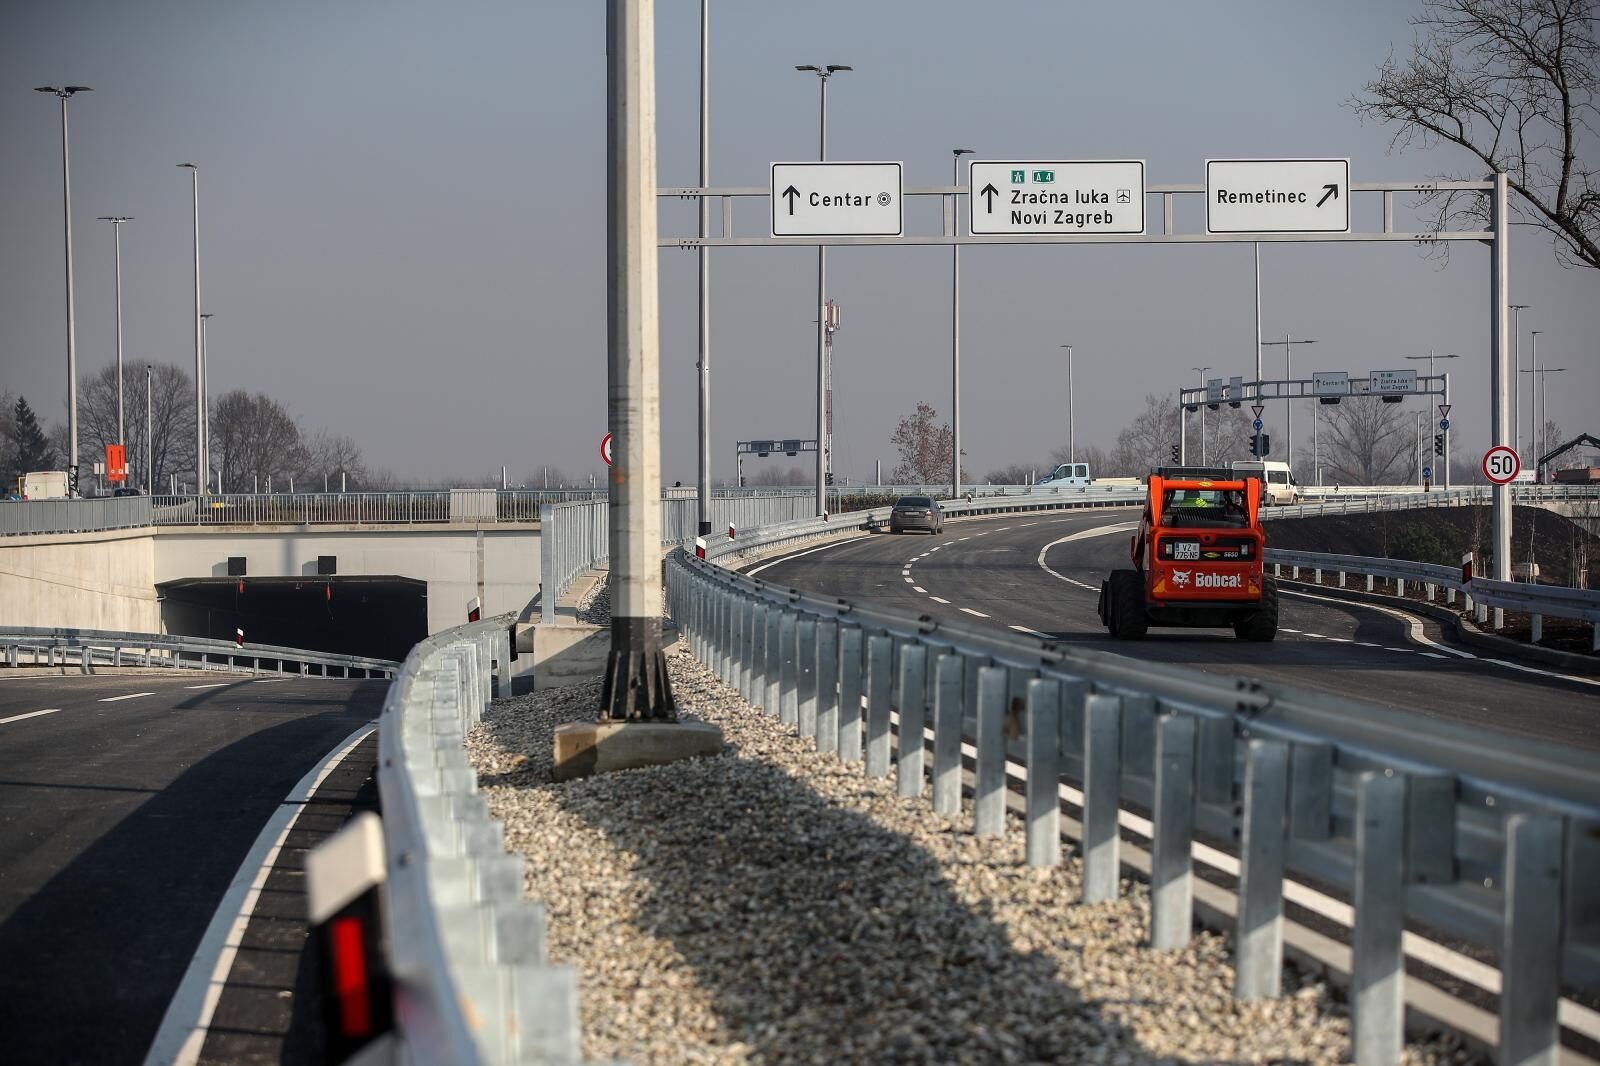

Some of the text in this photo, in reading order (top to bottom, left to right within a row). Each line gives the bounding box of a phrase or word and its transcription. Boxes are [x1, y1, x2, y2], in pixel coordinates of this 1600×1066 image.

[809, 192, 872, 207] Centar
[1011, 189, 1109, 205] Zračna luka
[1217, 189, 1308, 205] Remetinec
[1011, 210, 1113, 228] Novi Zagreb
[1491, 455, 1512, 475] 50
[1195, 572, 1242, 588] Bobcat
